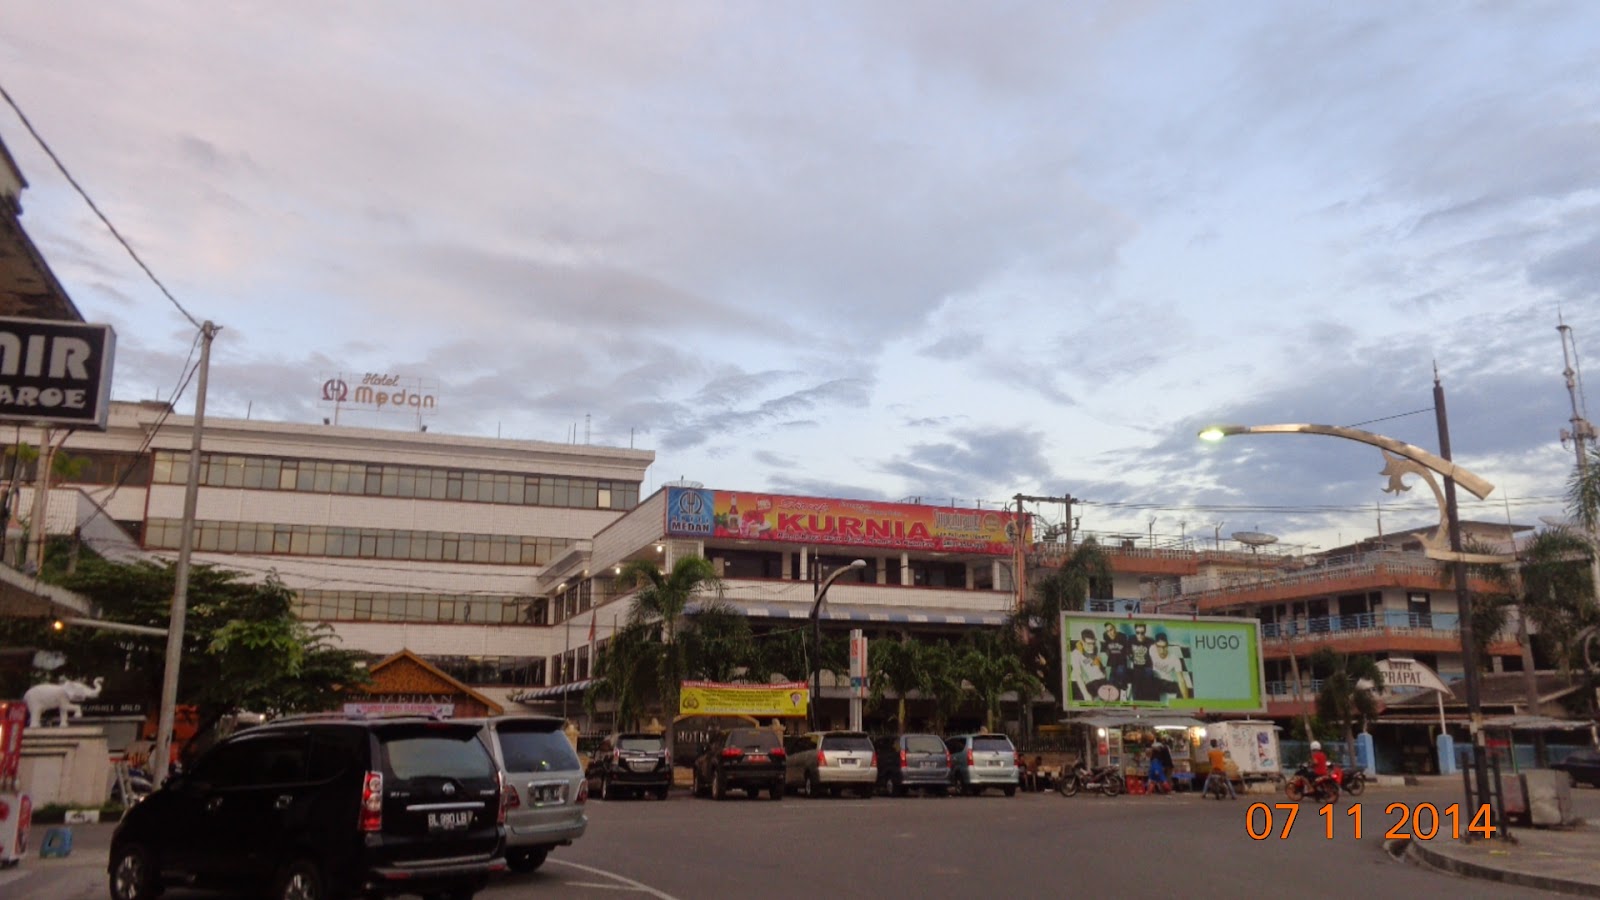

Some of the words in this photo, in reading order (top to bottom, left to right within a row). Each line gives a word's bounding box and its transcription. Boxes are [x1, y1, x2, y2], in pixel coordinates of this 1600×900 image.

[362, 373, 400, 387] Hotel
[671, 521, 710, 532] MEDAN
[777, 512, 932, 541] KURNIA
[1195, 634, 1240, 650] HUGO
